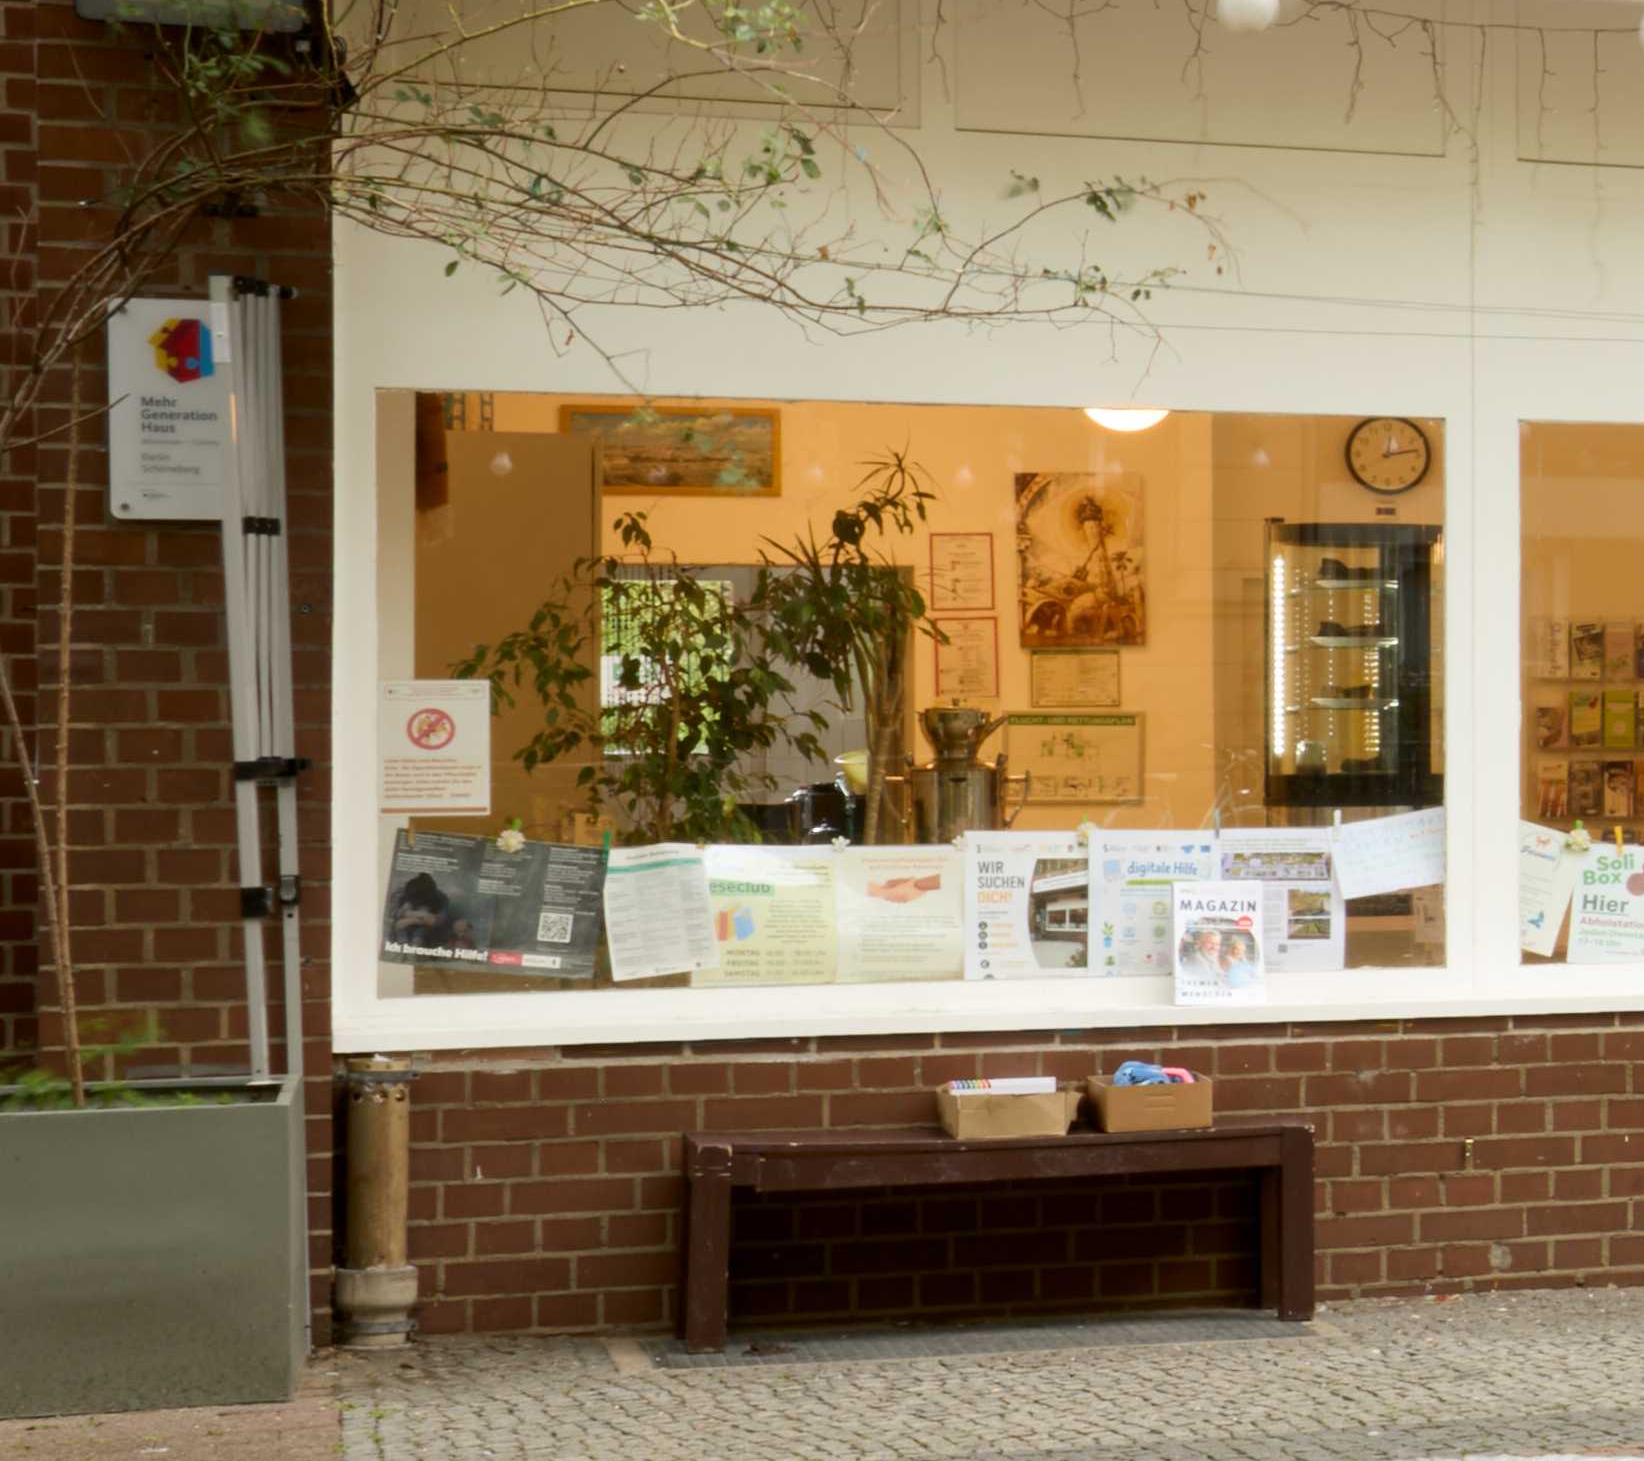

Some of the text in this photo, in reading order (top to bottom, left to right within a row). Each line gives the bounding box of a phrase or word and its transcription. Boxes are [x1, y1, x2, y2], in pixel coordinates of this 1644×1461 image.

[141, 396, 177, 407] Mehr
[141, 422, 176, 433] Haus
[977, 861, 1004, 875] WIR
[1127, 861, 1198, 877] digitale Hilfe
[1596, 854, 1635, 871] Soli
[977, 876, 1025, 889] SUCHEN
[1583, 870, 1622, 886] Box
[1179, 899, 1257, 913] MAGAZIN
[1582, 894, 1629, 913] Hier
